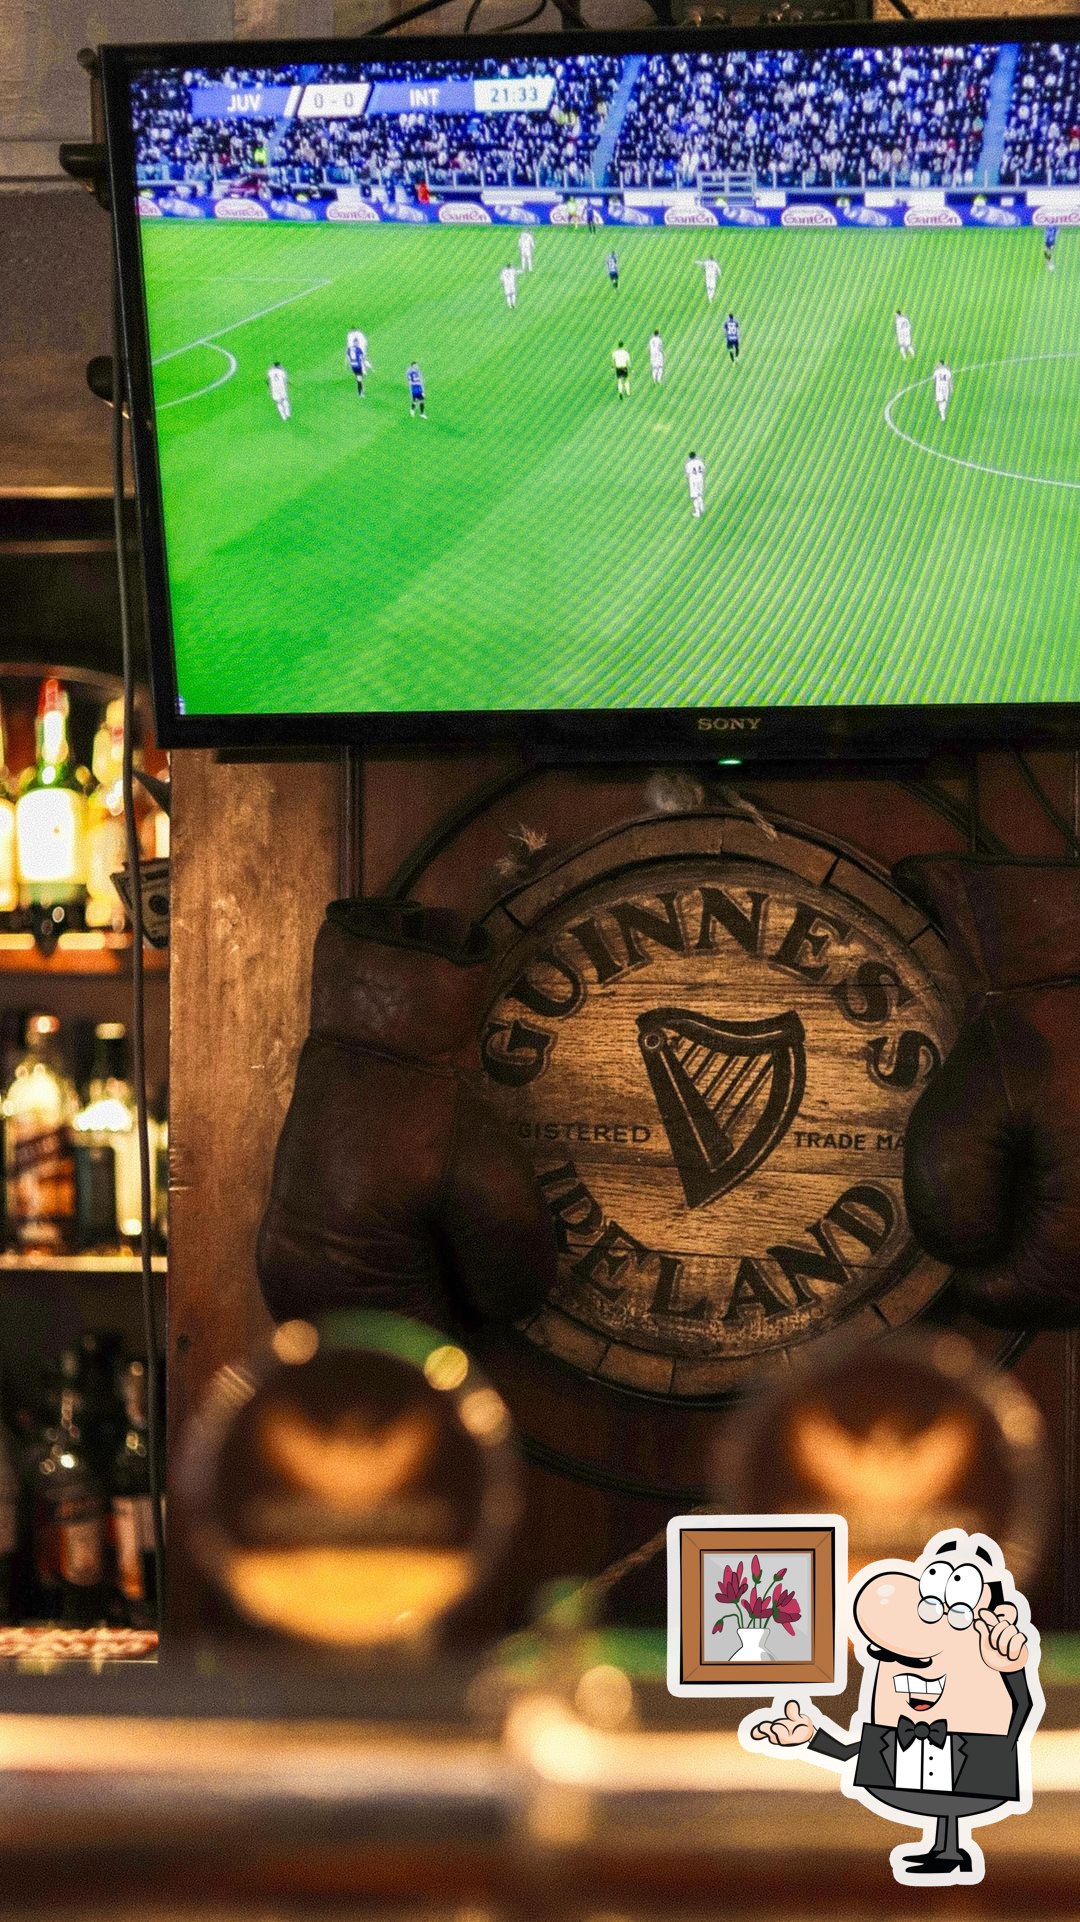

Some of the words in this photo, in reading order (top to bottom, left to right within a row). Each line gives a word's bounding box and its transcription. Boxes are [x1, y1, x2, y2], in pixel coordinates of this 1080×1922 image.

[227, 93, 261, 112] JUV
[409, 88, 440, 108] INT
[490, 86, 538, 103] 21:33
[697, 718, 761, 730] SONY
[480, 886, 944, 1090] GUINNESS
[518, 1121, 651, 1143] GISTERED
[794, 1131, 866, 1150] TRADE
[876, 1134, 906, 1150] MA
[536, 1161, 898, 1319] IRELAND
